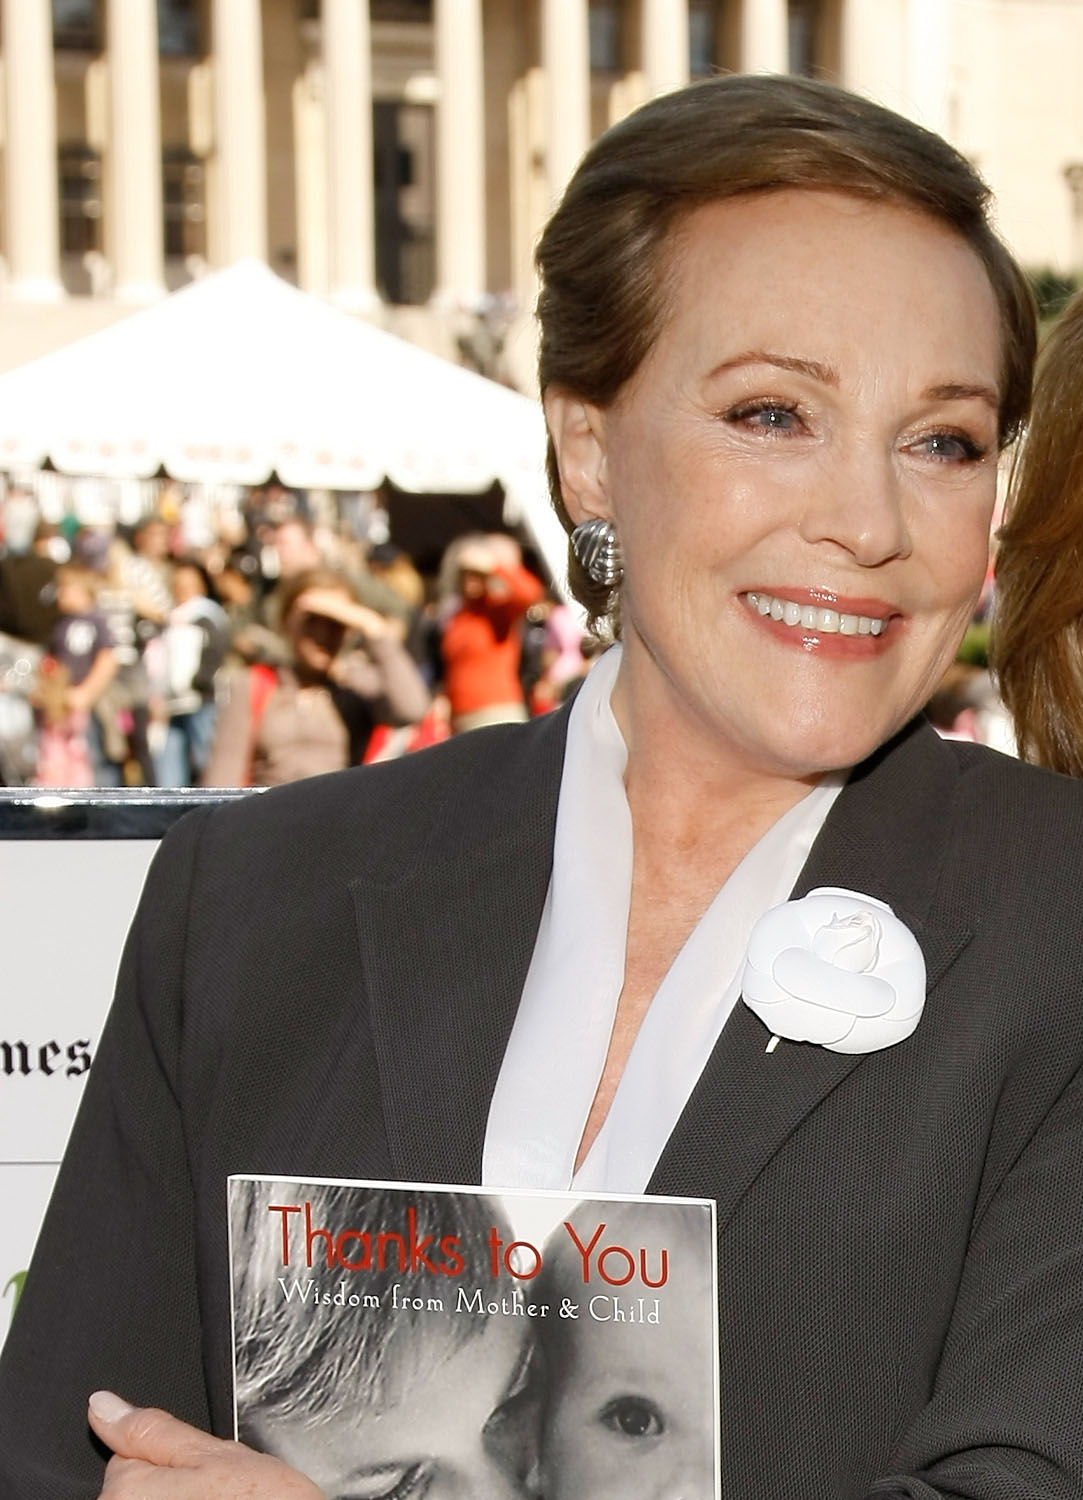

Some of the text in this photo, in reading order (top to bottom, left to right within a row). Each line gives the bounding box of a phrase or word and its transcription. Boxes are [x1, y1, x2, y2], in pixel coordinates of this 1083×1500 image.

[268, 1202, 669, 1289] Thanks to You
[277, 1277, 661, 1325] Wisdom from Mother & Child
